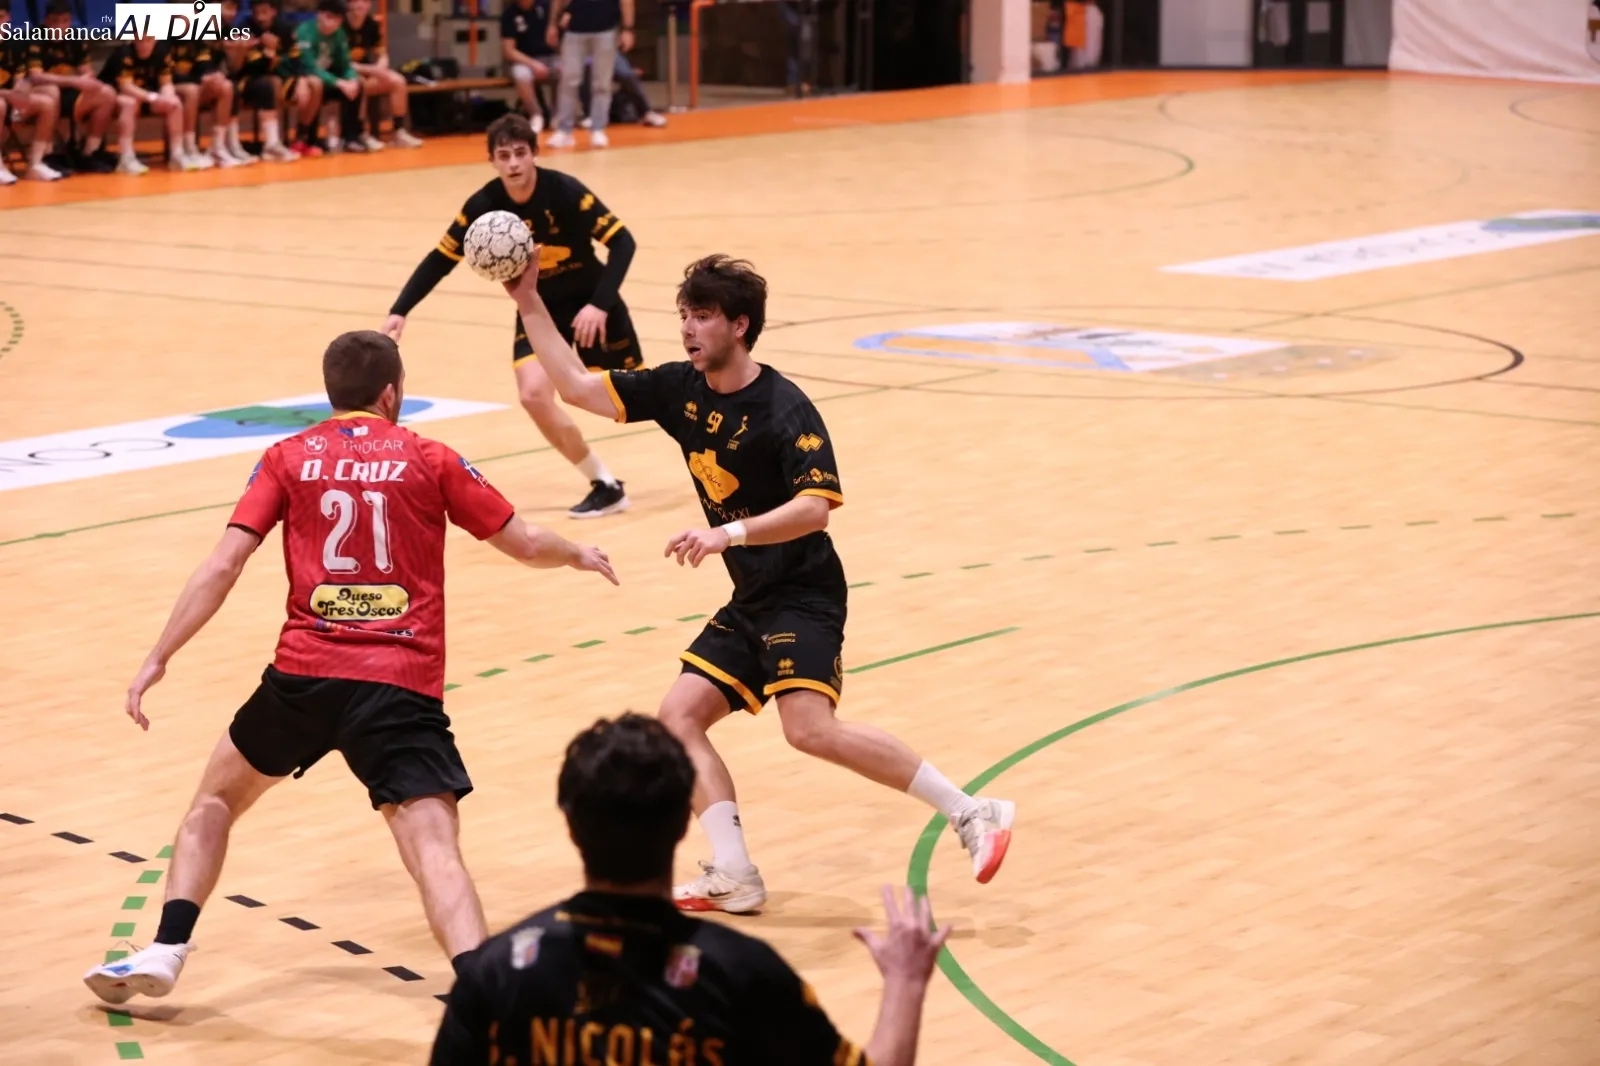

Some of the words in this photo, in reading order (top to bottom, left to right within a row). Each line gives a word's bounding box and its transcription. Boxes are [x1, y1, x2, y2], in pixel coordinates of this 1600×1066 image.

[300, 458, 329, 482] D.
[334, 458, 408, 483] CRUZ
[320, 489, 394, 575] 21
[336, 588, 382, 606] Queso
[317, 601, 354, 617] Tres
[356, 601, 402, 617] Oscos
